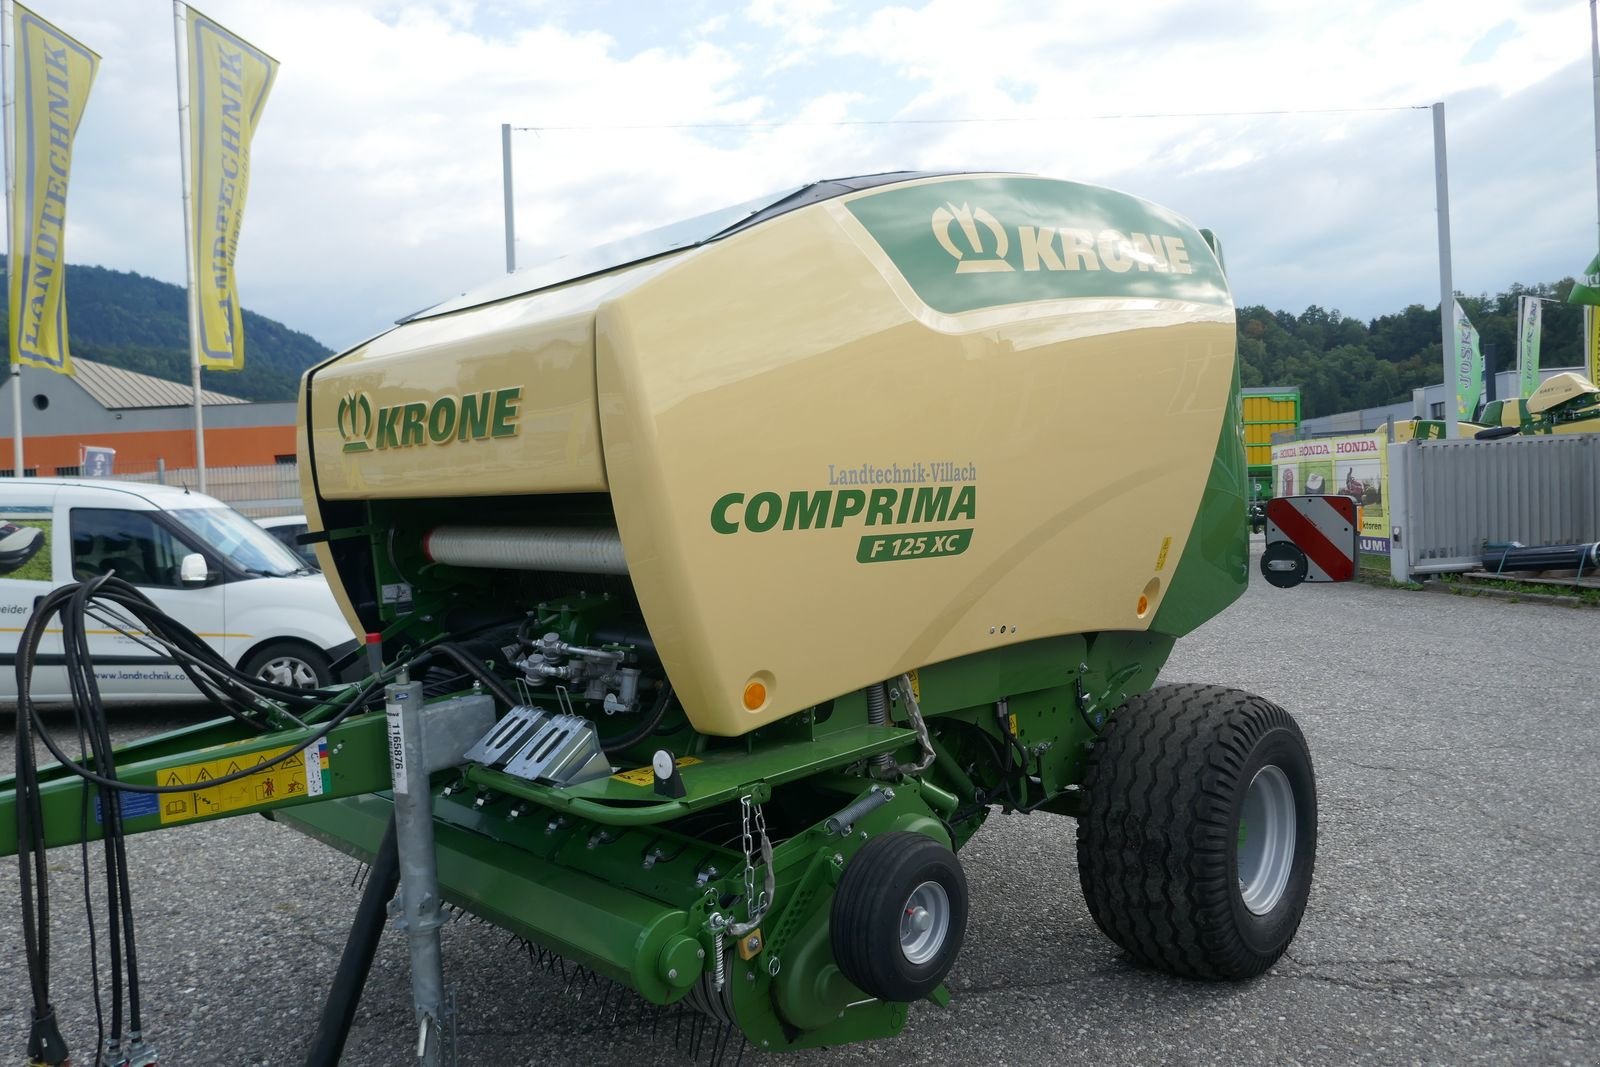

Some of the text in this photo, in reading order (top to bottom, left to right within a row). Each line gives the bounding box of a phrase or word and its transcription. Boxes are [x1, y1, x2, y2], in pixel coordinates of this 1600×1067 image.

[25, 38, 70, 348] LANDTECHNIK
[1018, 225, 1193, 275] KRONE
[375, 386, 523, 450] KRONE
[1298, 444, 1330, 457] HONDA
[1336, 440, 1377, 453] HONDA
[828, 462, 977, 485] Landtechnik-Villach
[710, 485, 976, 534] COMPRIMA
[870, 534, 960, 558] F 125 XC
[392, 723, 404, 769] 1165876
